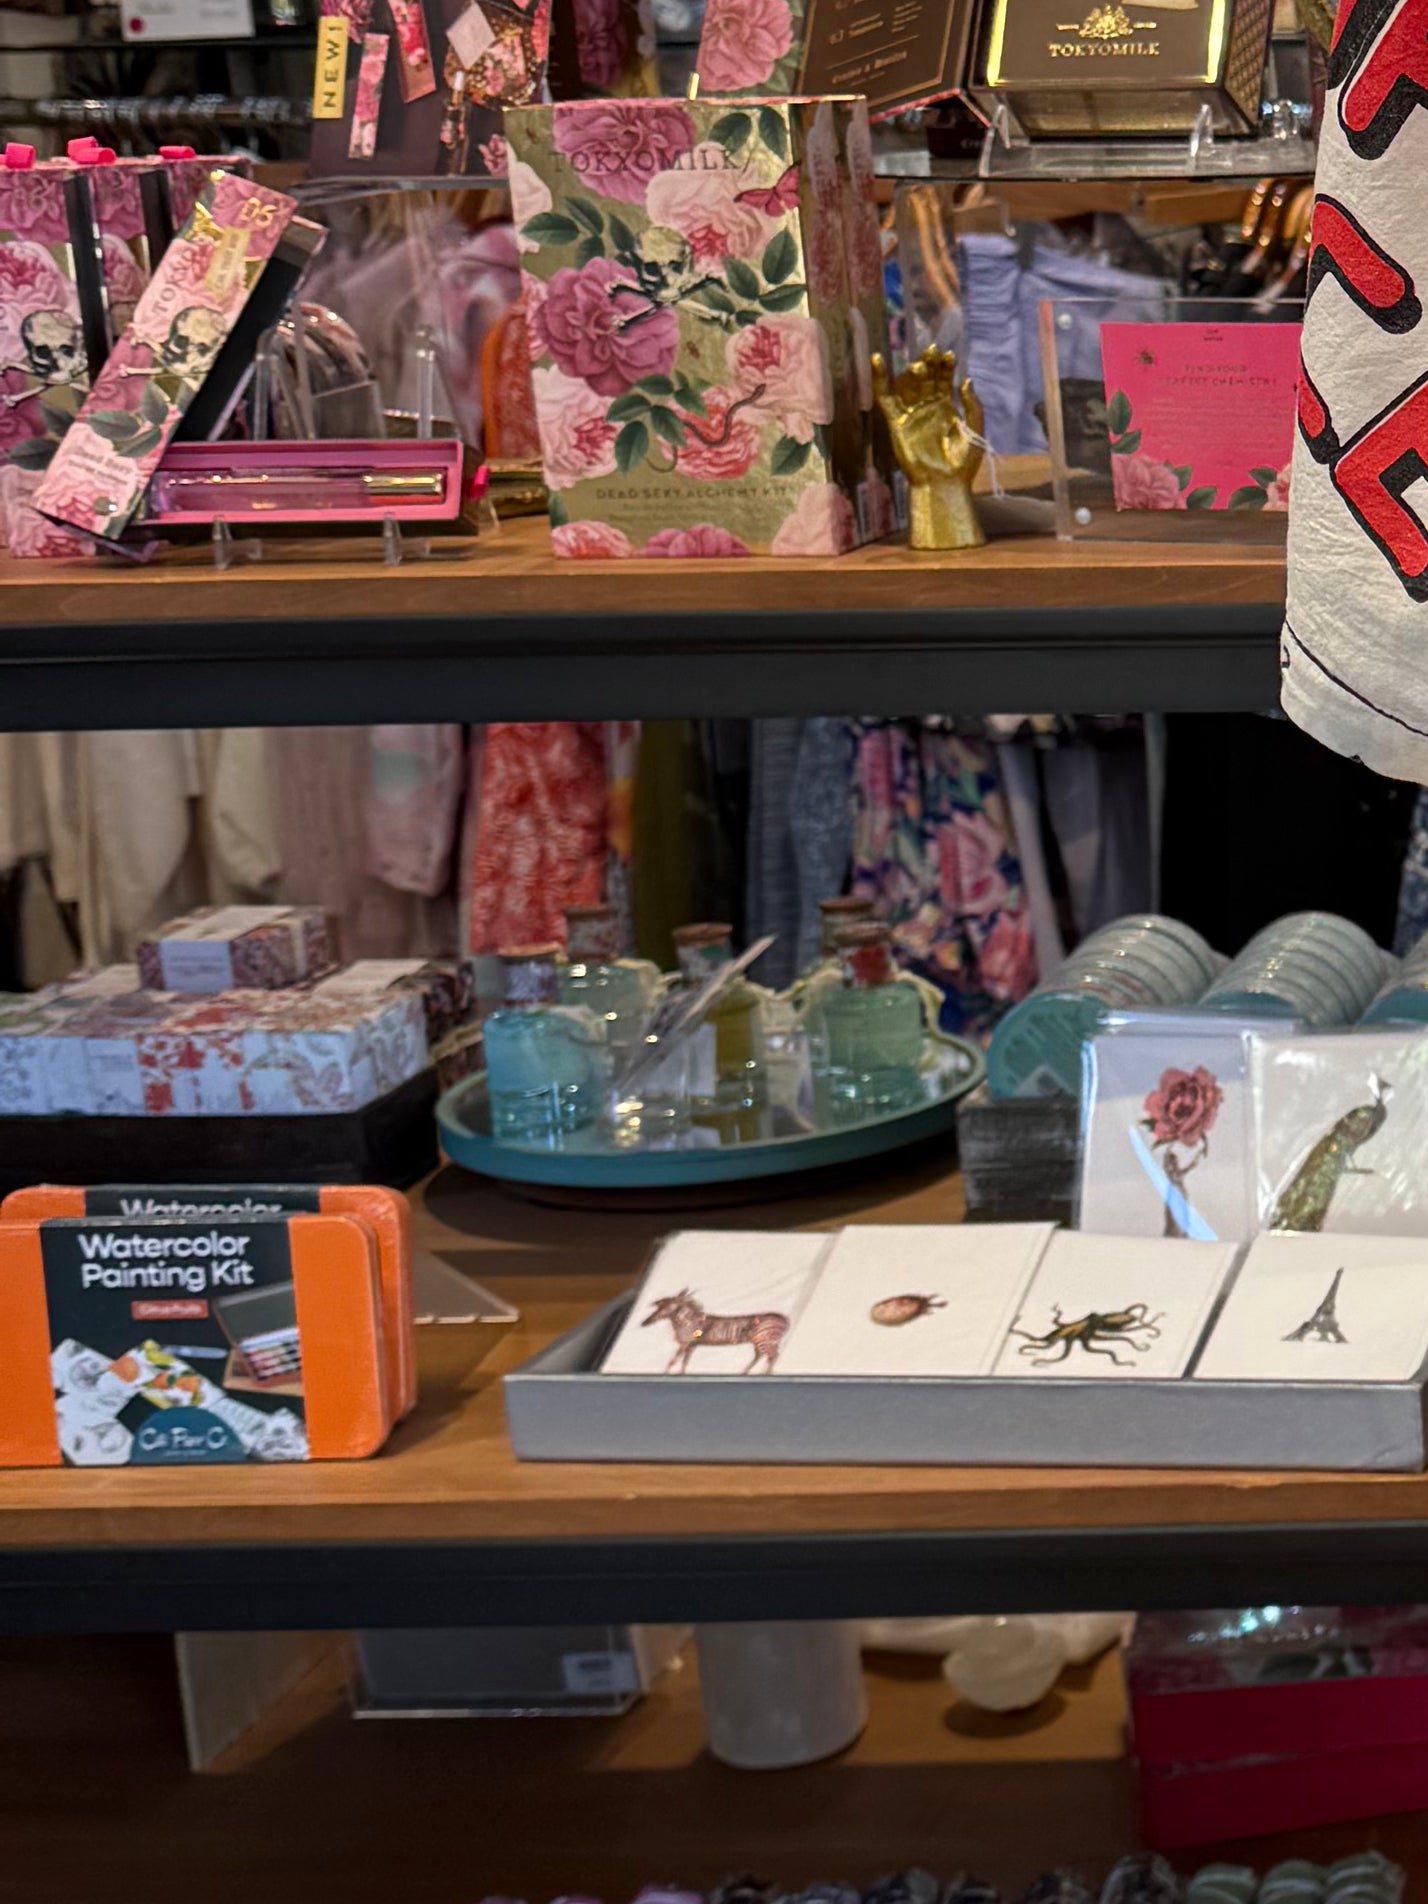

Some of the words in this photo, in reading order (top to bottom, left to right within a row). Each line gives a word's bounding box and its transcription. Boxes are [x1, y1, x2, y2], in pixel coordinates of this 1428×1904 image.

[1048, 42, 1160, 58] TOKYOMILK
[322, 24, 344, 109] NEW!
[77, 1231, 251, 1259] Watercolor
[81, 1262, 207, 1293] Painting
[211, 1260, 255, 1287] Kit
